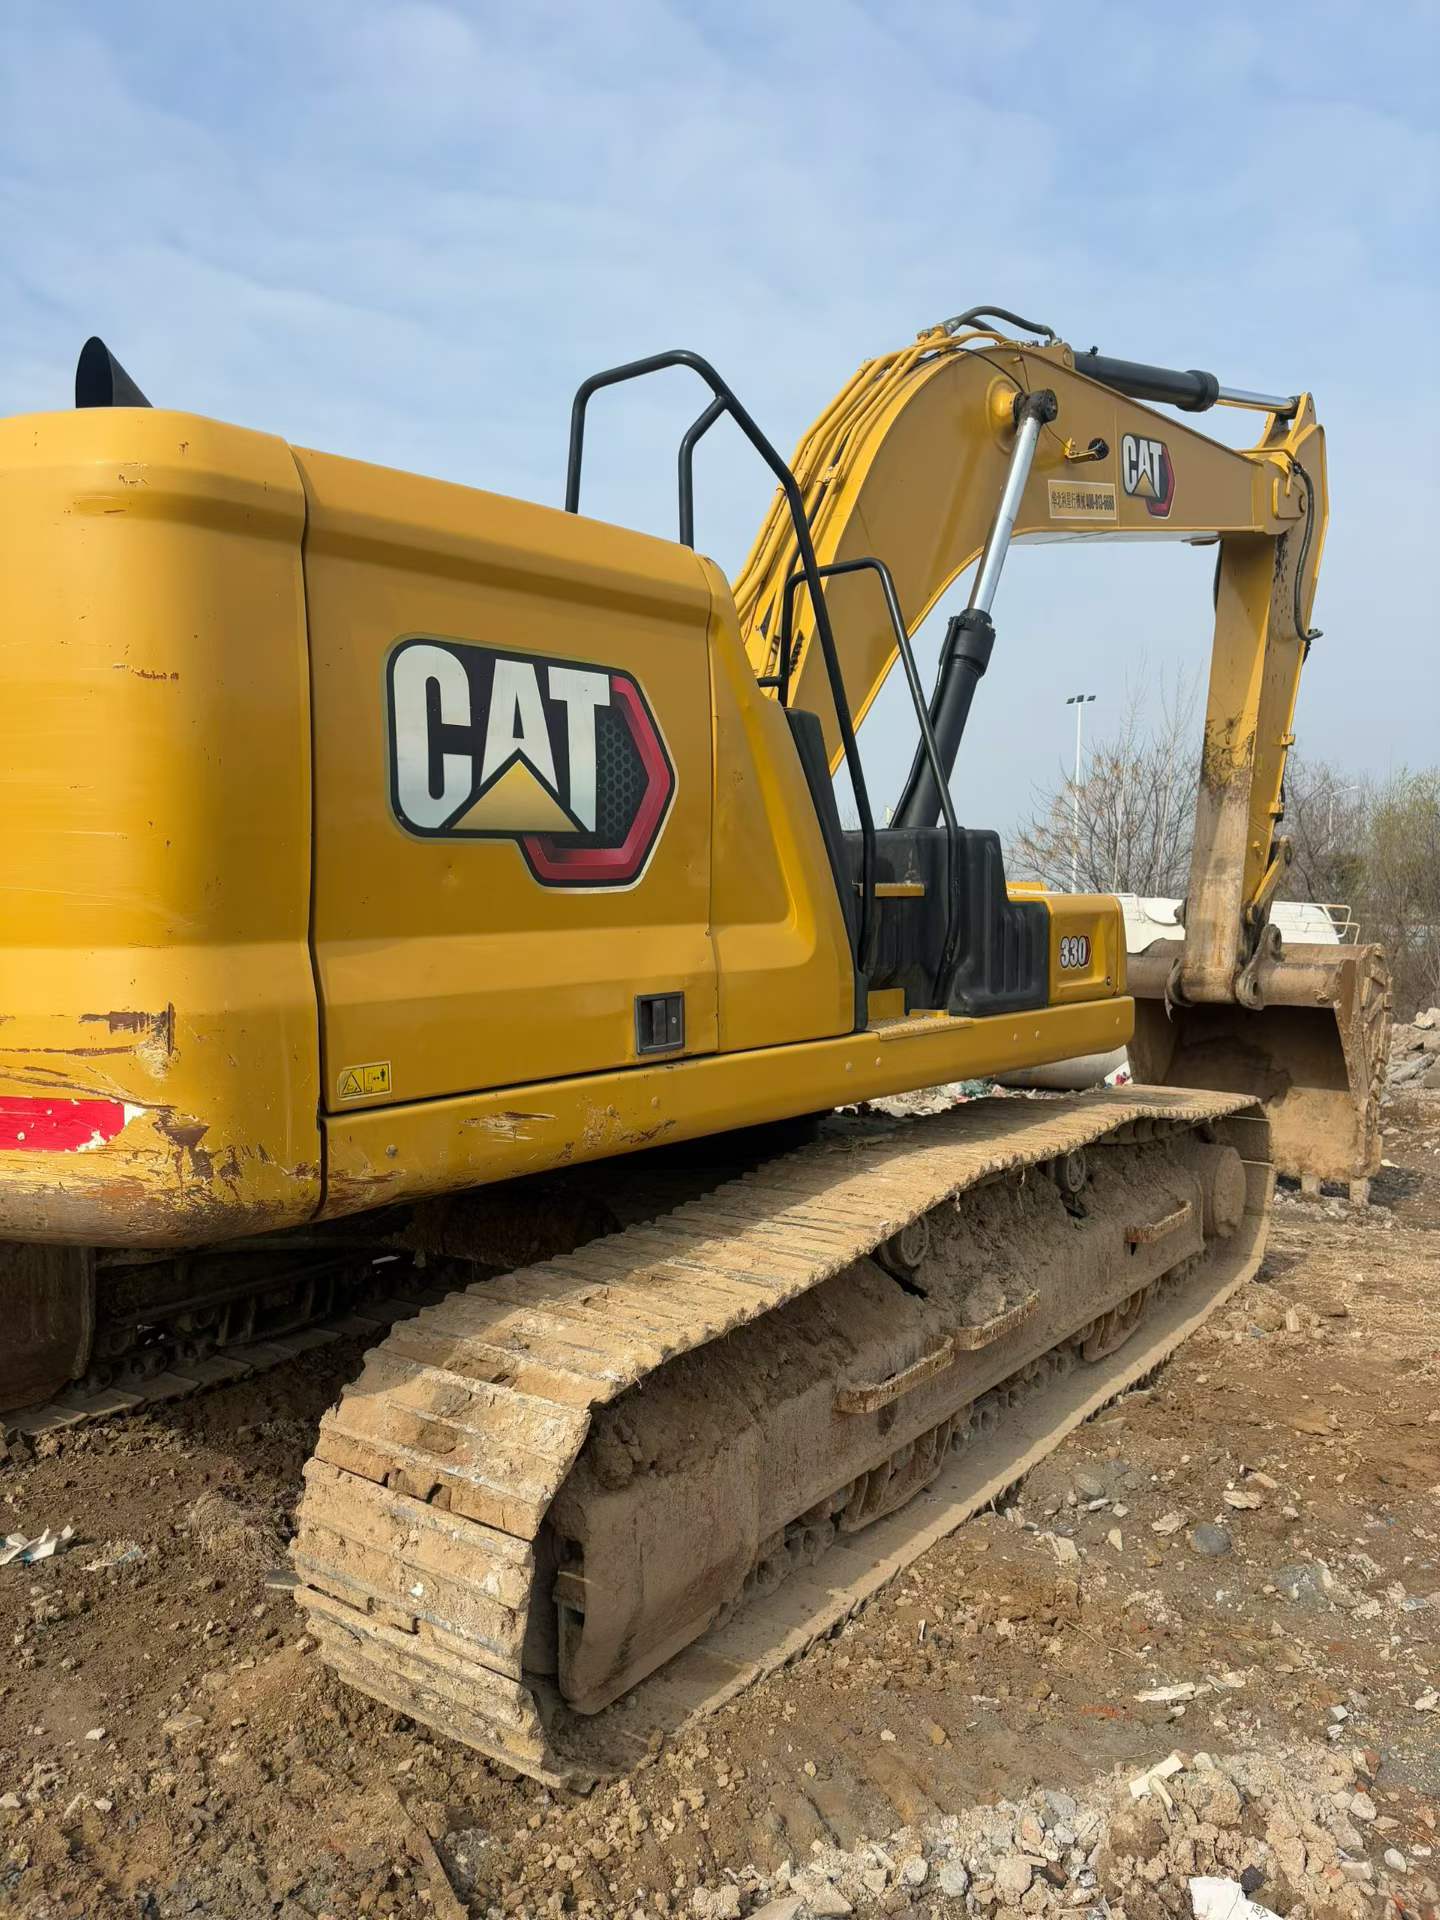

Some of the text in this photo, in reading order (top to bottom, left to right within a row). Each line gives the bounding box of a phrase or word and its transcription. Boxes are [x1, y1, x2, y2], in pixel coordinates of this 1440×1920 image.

[1122, 434, 1162, 498] CAT
[394, 645, 611, 833] CAT
[1061, 936, 1088, 968] 330
